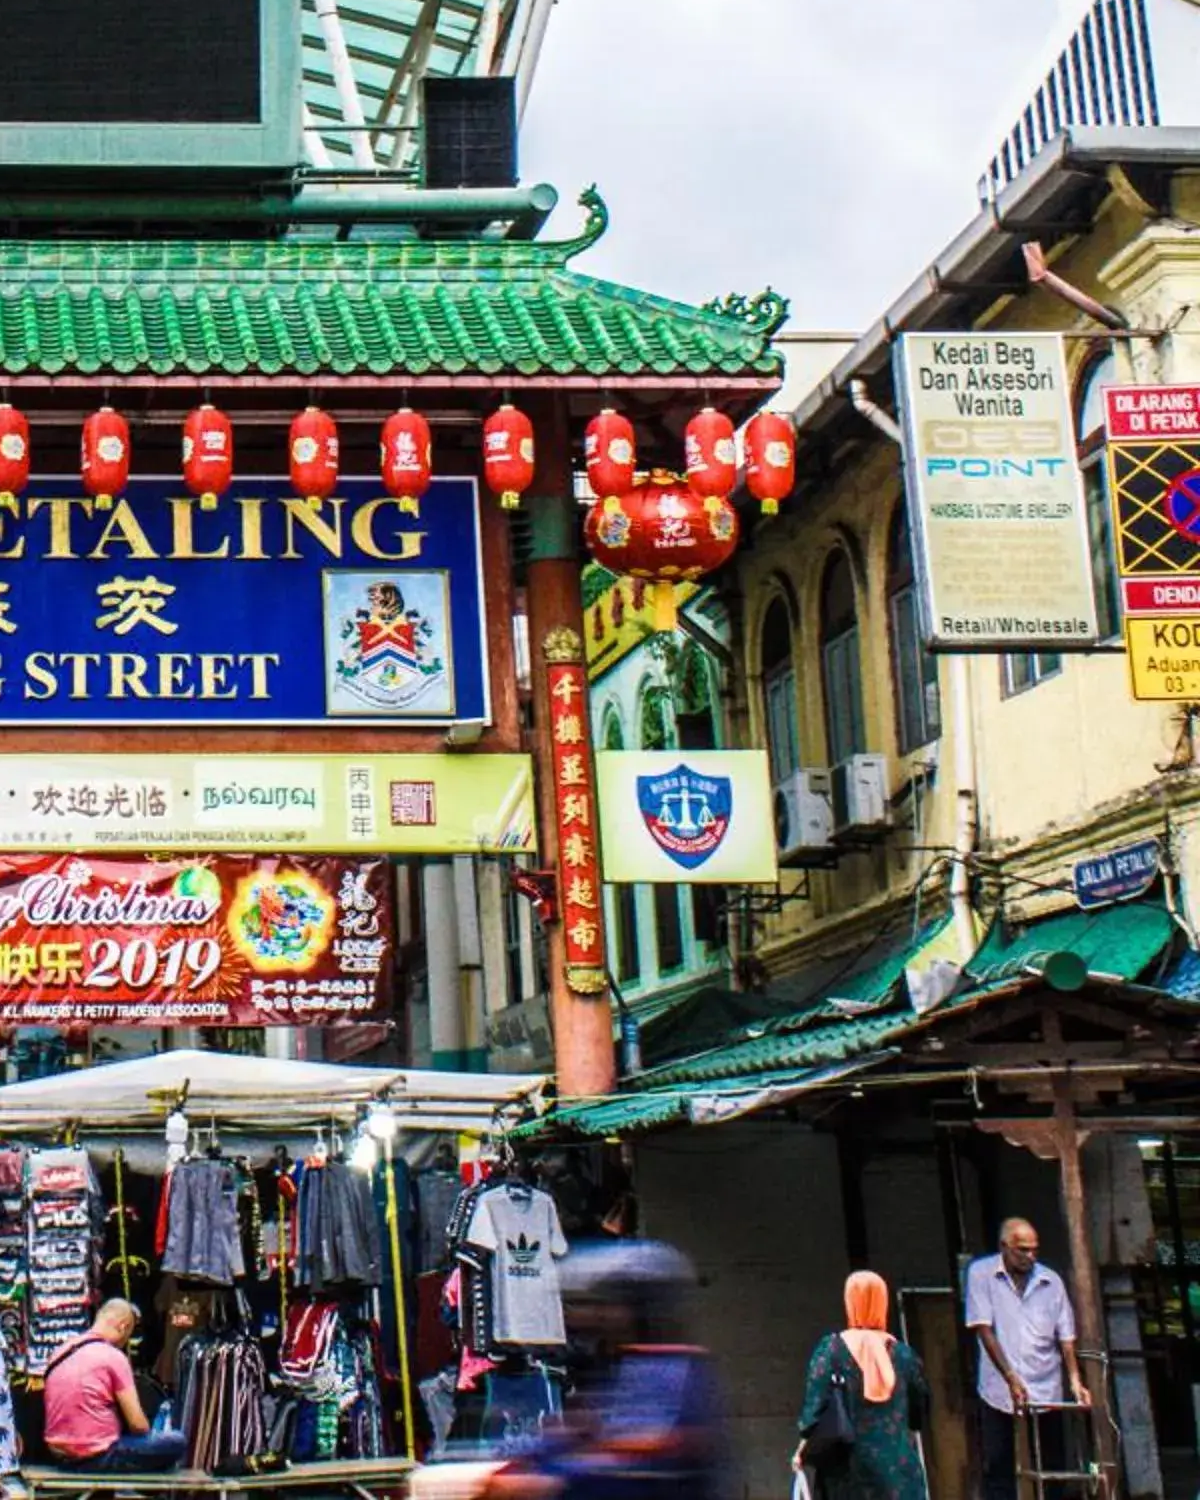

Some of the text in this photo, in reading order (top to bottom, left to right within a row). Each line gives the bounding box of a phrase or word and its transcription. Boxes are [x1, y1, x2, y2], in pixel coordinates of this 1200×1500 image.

[933, 341, 1036, 372] Kedai Beg
[920, 366, 1054, 391] Dan Aksesori
[955, 391, 1025, 417] Wanita
[1115, 393, 1193, 413] DILARANG
[1129, 411, 1200, 431] DI PETAK
[941, 617, 1090, 635] Retail/Wholesale
[24, 651, 281, 700] STREET
[1166, 675, 1185, 693] 03
[31, 784, 170, 819] 欢迎光临
[202, 780, 317, 811] நல்வரவு
[348, 767, 374, 837] 丙申年
[19, 874, 216, 927] Christmas
[83, 937, 223, 991] 2019
[84, 1003, 116, 1018] PETTY
[164, 1003, 229, 1018] ASSOCIATION
